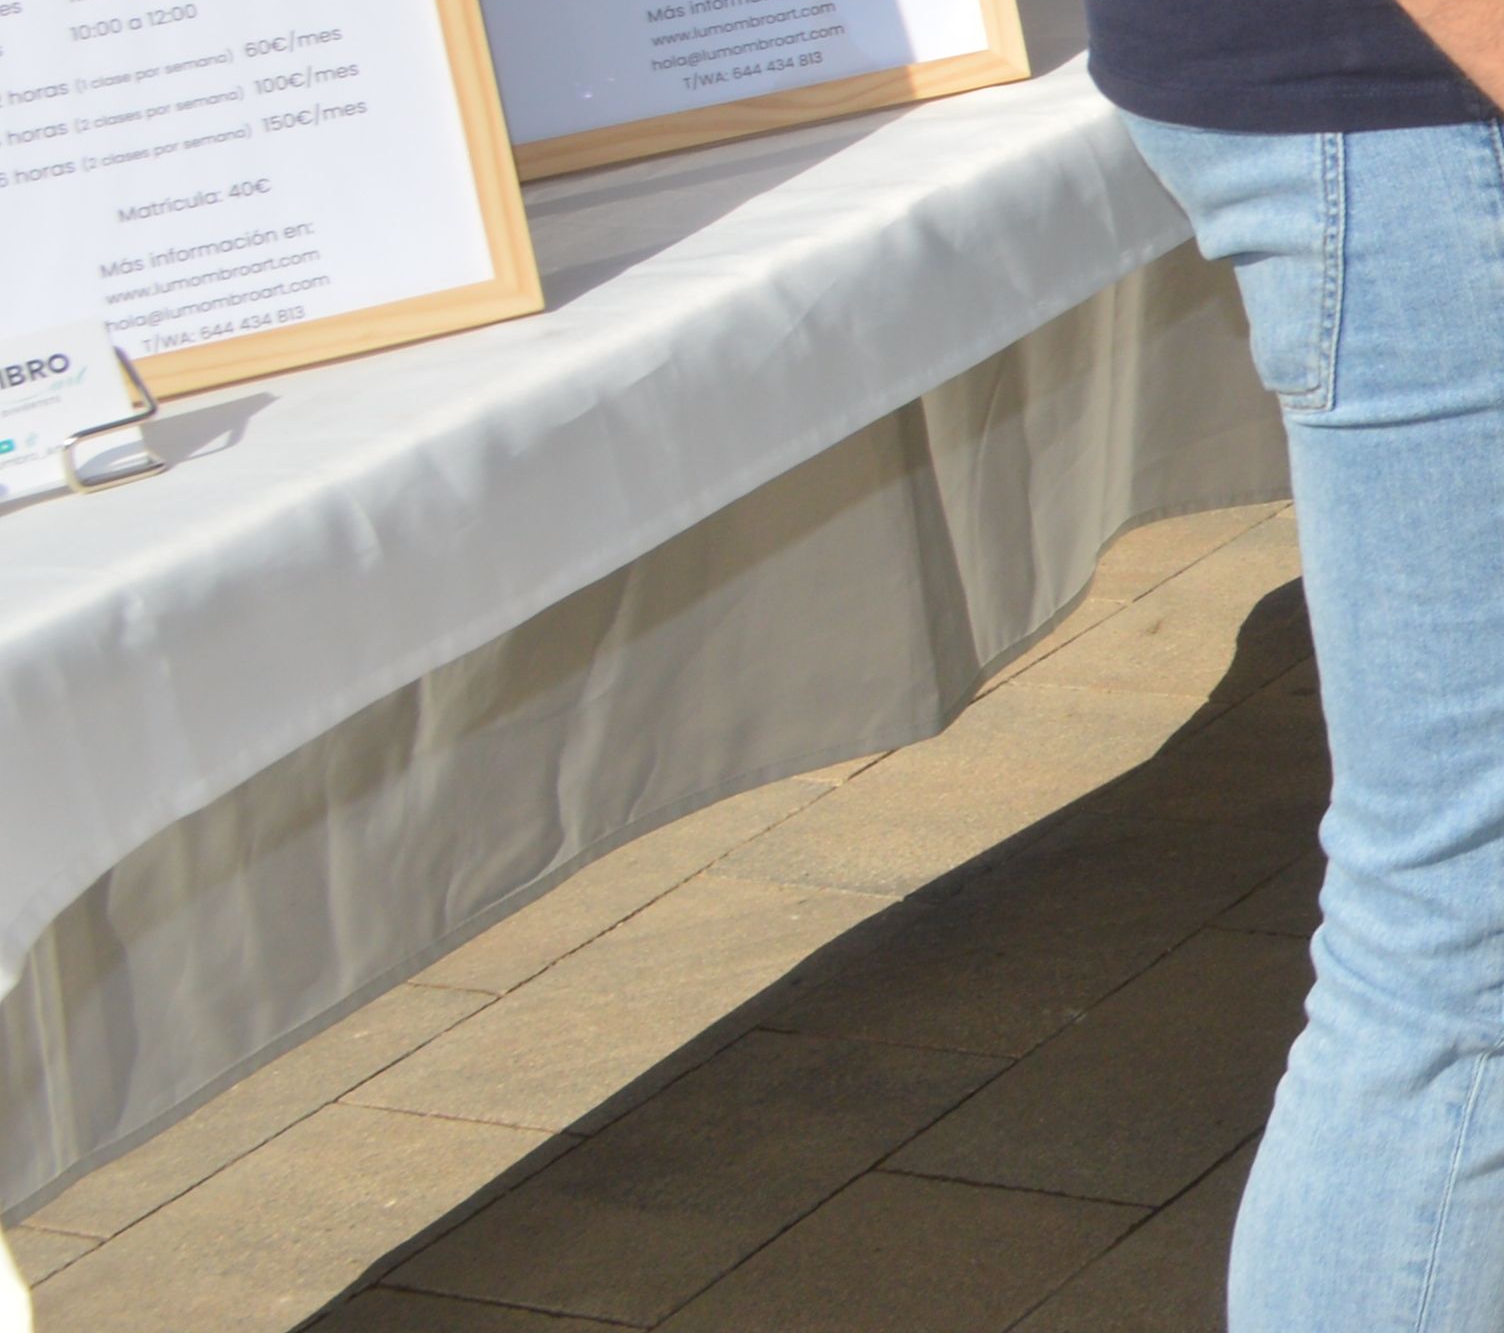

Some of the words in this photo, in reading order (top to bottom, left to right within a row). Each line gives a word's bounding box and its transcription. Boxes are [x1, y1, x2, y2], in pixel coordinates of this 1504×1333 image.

[69, 17, 123, 43] 10:00
[128, 15, 143, 31] a
[146, 2, 198, 28] 12:00
[646, 3, 687, 25] Más
[650, 0, 837, 48] www.lumombroart.com
[8, 82, 70, 106] horas
[91, 72, 132, 90] clase
[135, 67, 161, 84] por
[164, 47, 235, 75] semana)
[243, 25, 344, 59] 60€/mes
[650, 22, 846, 73] hola@lumombroart.com
[683, 69, 729, 91] T/WA:
[732, 62, 764, 80] 644
[766, 55, 795, 73] 434
[798, 50, 824, 68] 813
[6, 121, 69, 146] horas
[74, 116, 91, 135] (2
[93, 108, 143, 130] clases
[146, 103, 172, 121] por
[175, 85, 246, 113] semana)
[254, 61, 361, 97] 100€/mes
[13, 159, 77, 185] horas
[81, 155, 99, 173] (2
[101, 146, 152, 168] clases
[153, 141, 179, 159] por
[183, 123, 254, 152] semana)
[261, 99, 368, 134] 150€/mes
[117, 187, 224, 224] Matrícula:
[227, 177, 273, 200] 40€
[98, 255, 146, 280] Más
[150, 228, 279, 269] información
[283, 220, 315, 241] en:
[104, 247, 321, 306] www.lumombroart.com
[141, 328, 198, 355] T/WA:
[199, 320, 236, 343] 644
[238, 311, 274, 334] 434
[277, 304, 307, 328] 813
[0, 352, 71, 390] BRO
